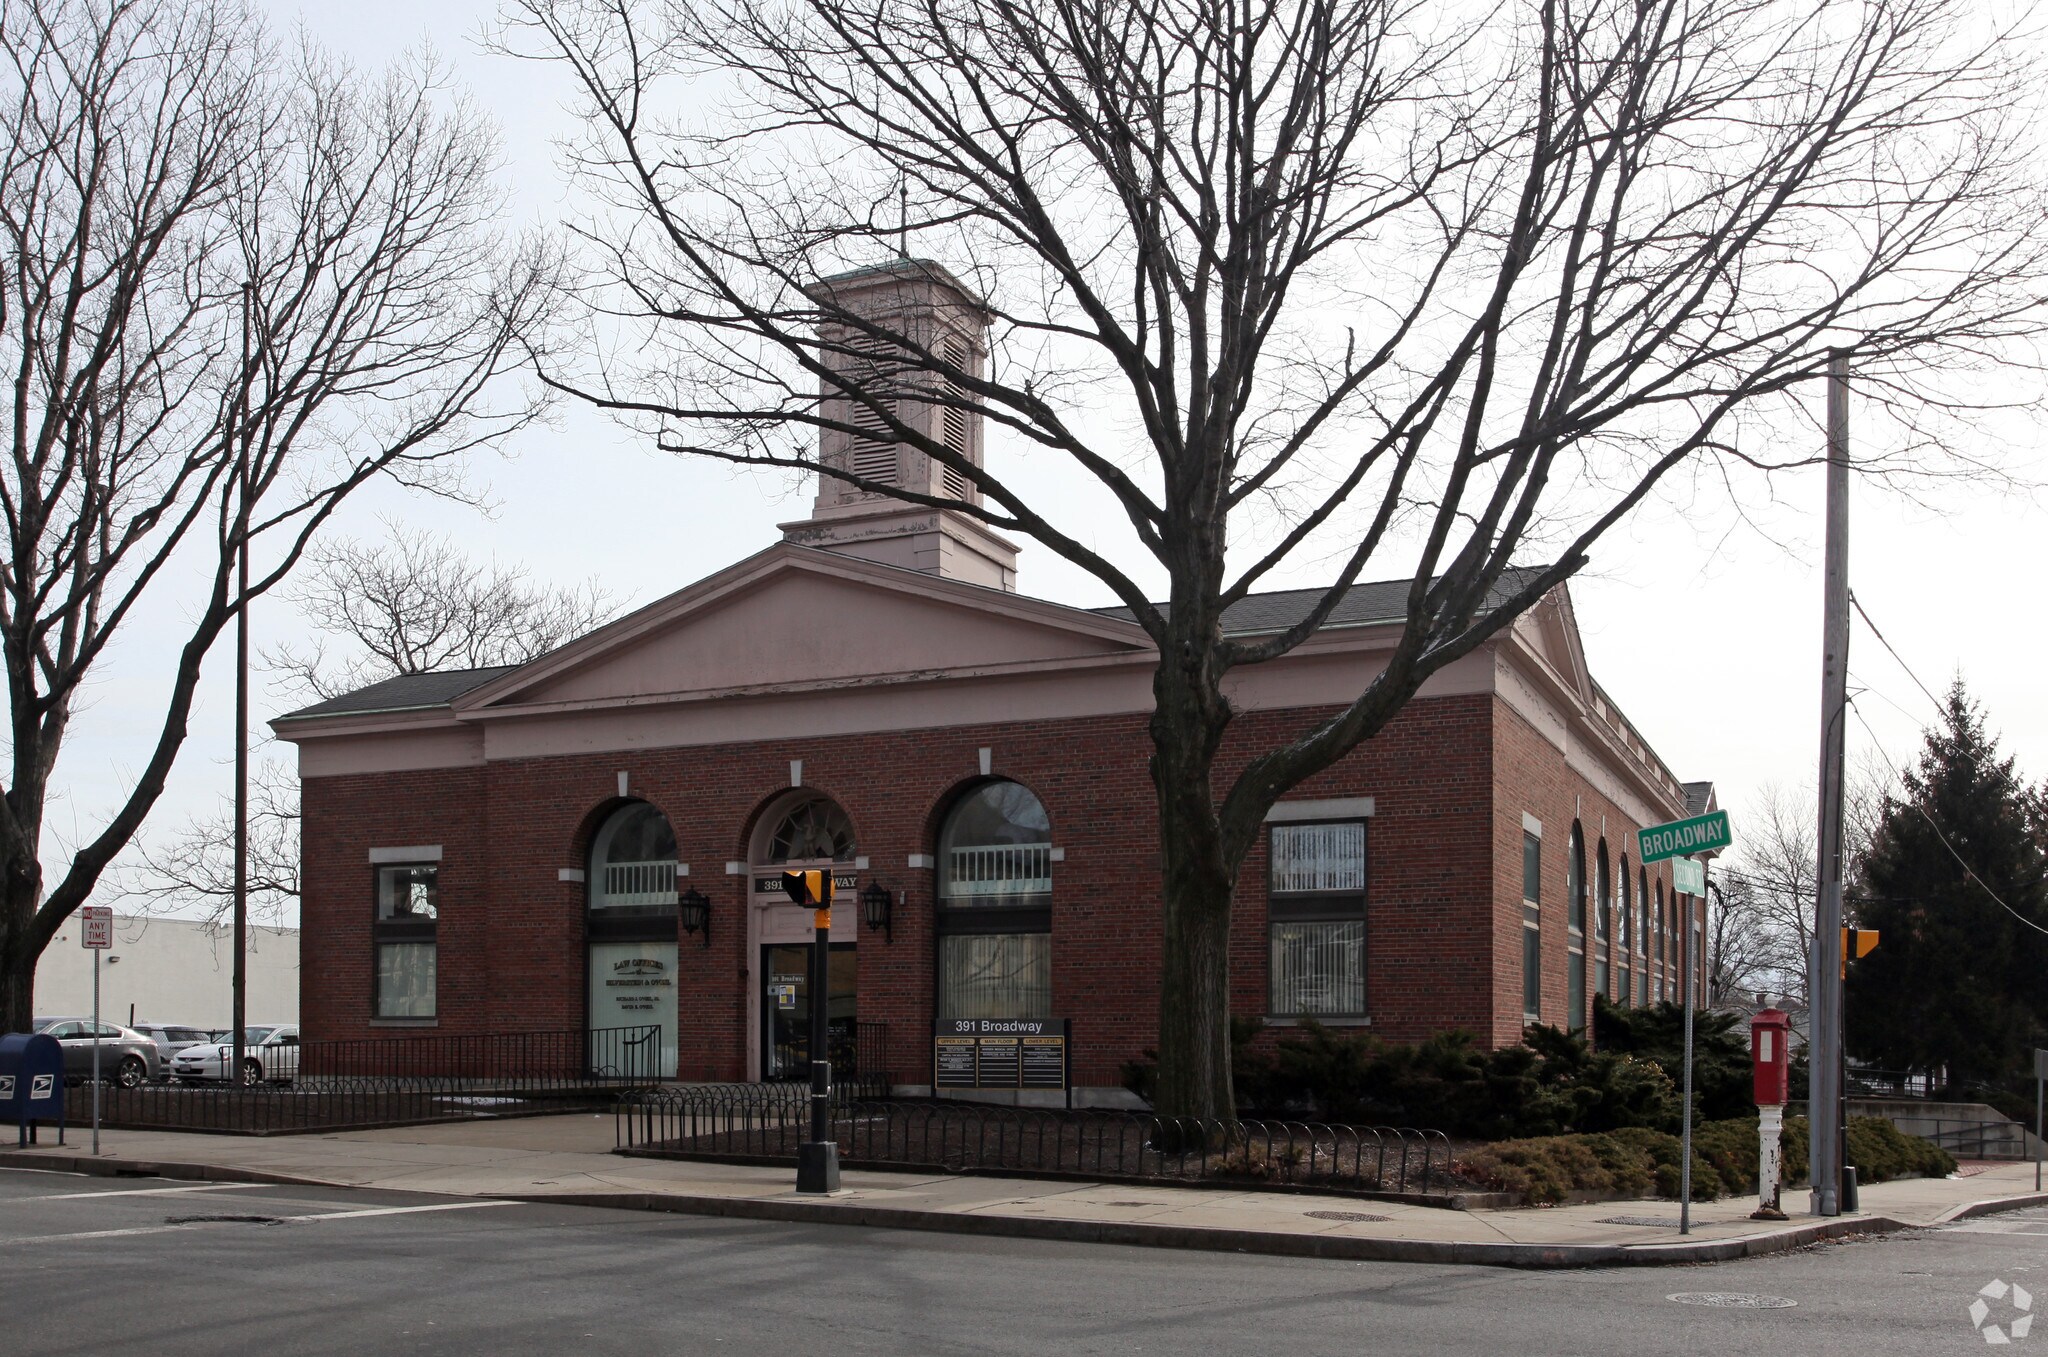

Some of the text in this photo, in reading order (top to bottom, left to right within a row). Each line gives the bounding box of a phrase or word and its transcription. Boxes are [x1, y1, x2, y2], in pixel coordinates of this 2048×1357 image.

[1642, 819, 1723, 856] BROADWAY
[1675, 863, 1702, 889] SECOND ST
[764, 881, 783, 890] 391
[83, 909, 92, 918] NO
[89, 922, 105, 930] ANY
[88, 931, 106, 940] TIME
[614, 959, 664, 971] LAW OFFICES
[780, 975, 805, 983] Broadway
[955, 1020, 1042, 1034] 391 Broadway
